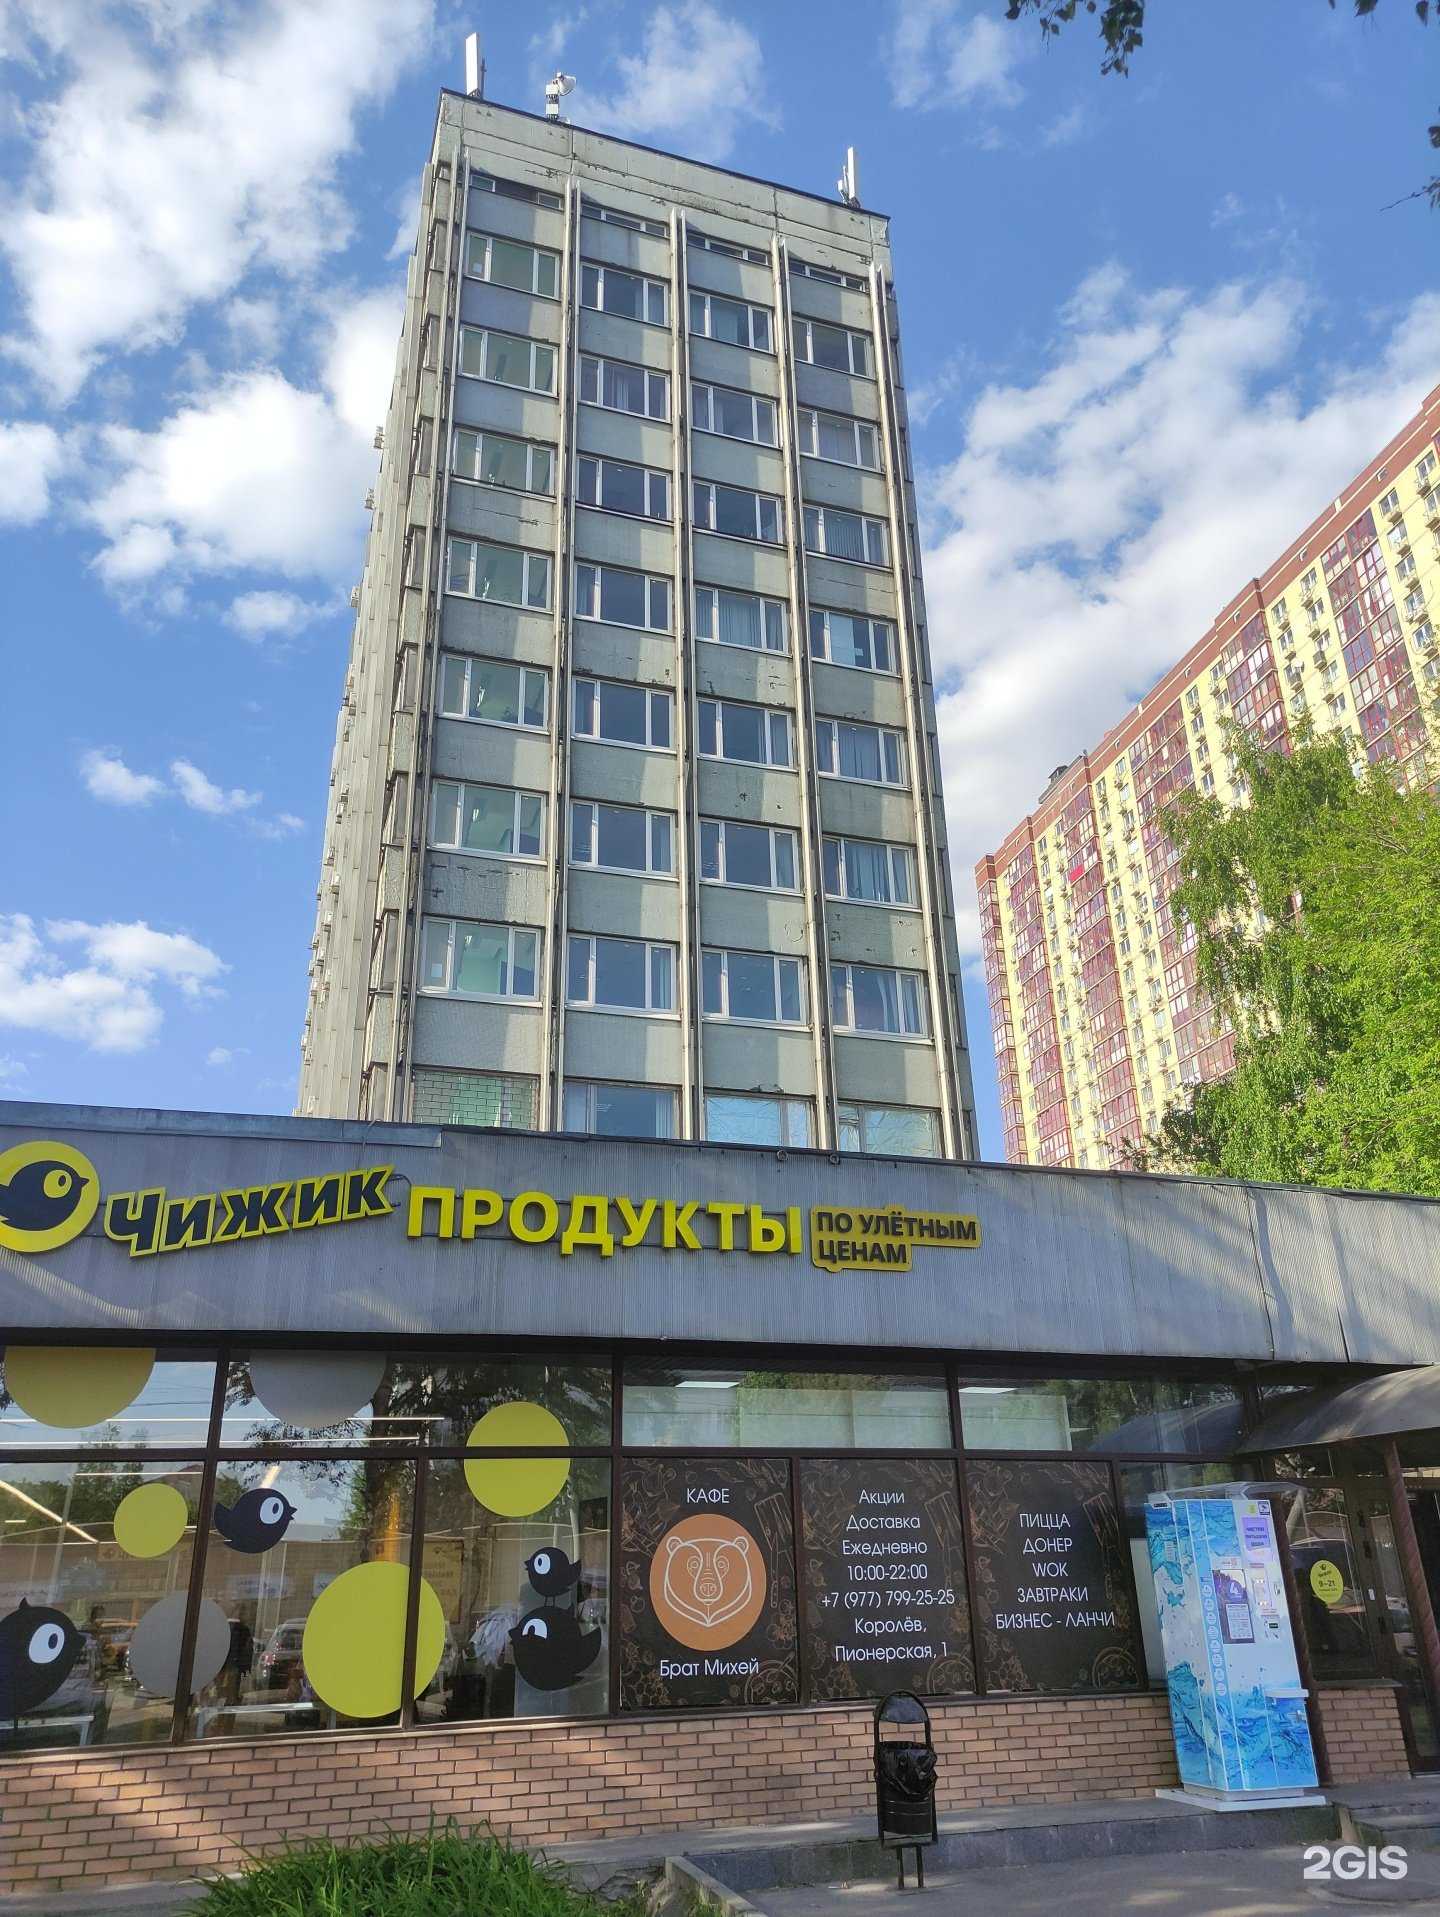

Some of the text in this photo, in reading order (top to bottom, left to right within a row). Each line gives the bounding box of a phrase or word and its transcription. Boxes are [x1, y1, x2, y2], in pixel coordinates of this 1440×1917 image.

[407, 1185, 802, 1258] ПРОДУКТЫ
[817, 1210, 977, 1241] ПО УЛЁТНЫМ
[818, 1239, 907, 1264] ЦЕНАМ
[686, 1488, 731, 1504] КАФЕ
[858, 1489, 905, 1507] Акции
[846, 1514, 921, 1532] Доставка
[1019, 1513, 1071, 1530] ПИЦЦА
[842, 1540, 928, 1557] Ежедневно
[1023, 1538, 1073, 1554] ДОНЕР
[848, 1564, 928, 1581] 10:00-22:00
[1032, 1562, 1069, 1577] WOK
[821, 1589, 955, 1609] +7 (977) 799-25-25
[1017, 1586, 1089, 1603] ЗАВТРАКИ
[855, 1616, 928, 1637] Королёв,
[995, 1612, 1053, 1629] БИЗНЕС
[1065, 1611, 1116, 1627] ЛАНЧИ
[835, 1641, 948, 1663] Пионерская, 1
[660, 1657, 759, 1679] Брат Михей
